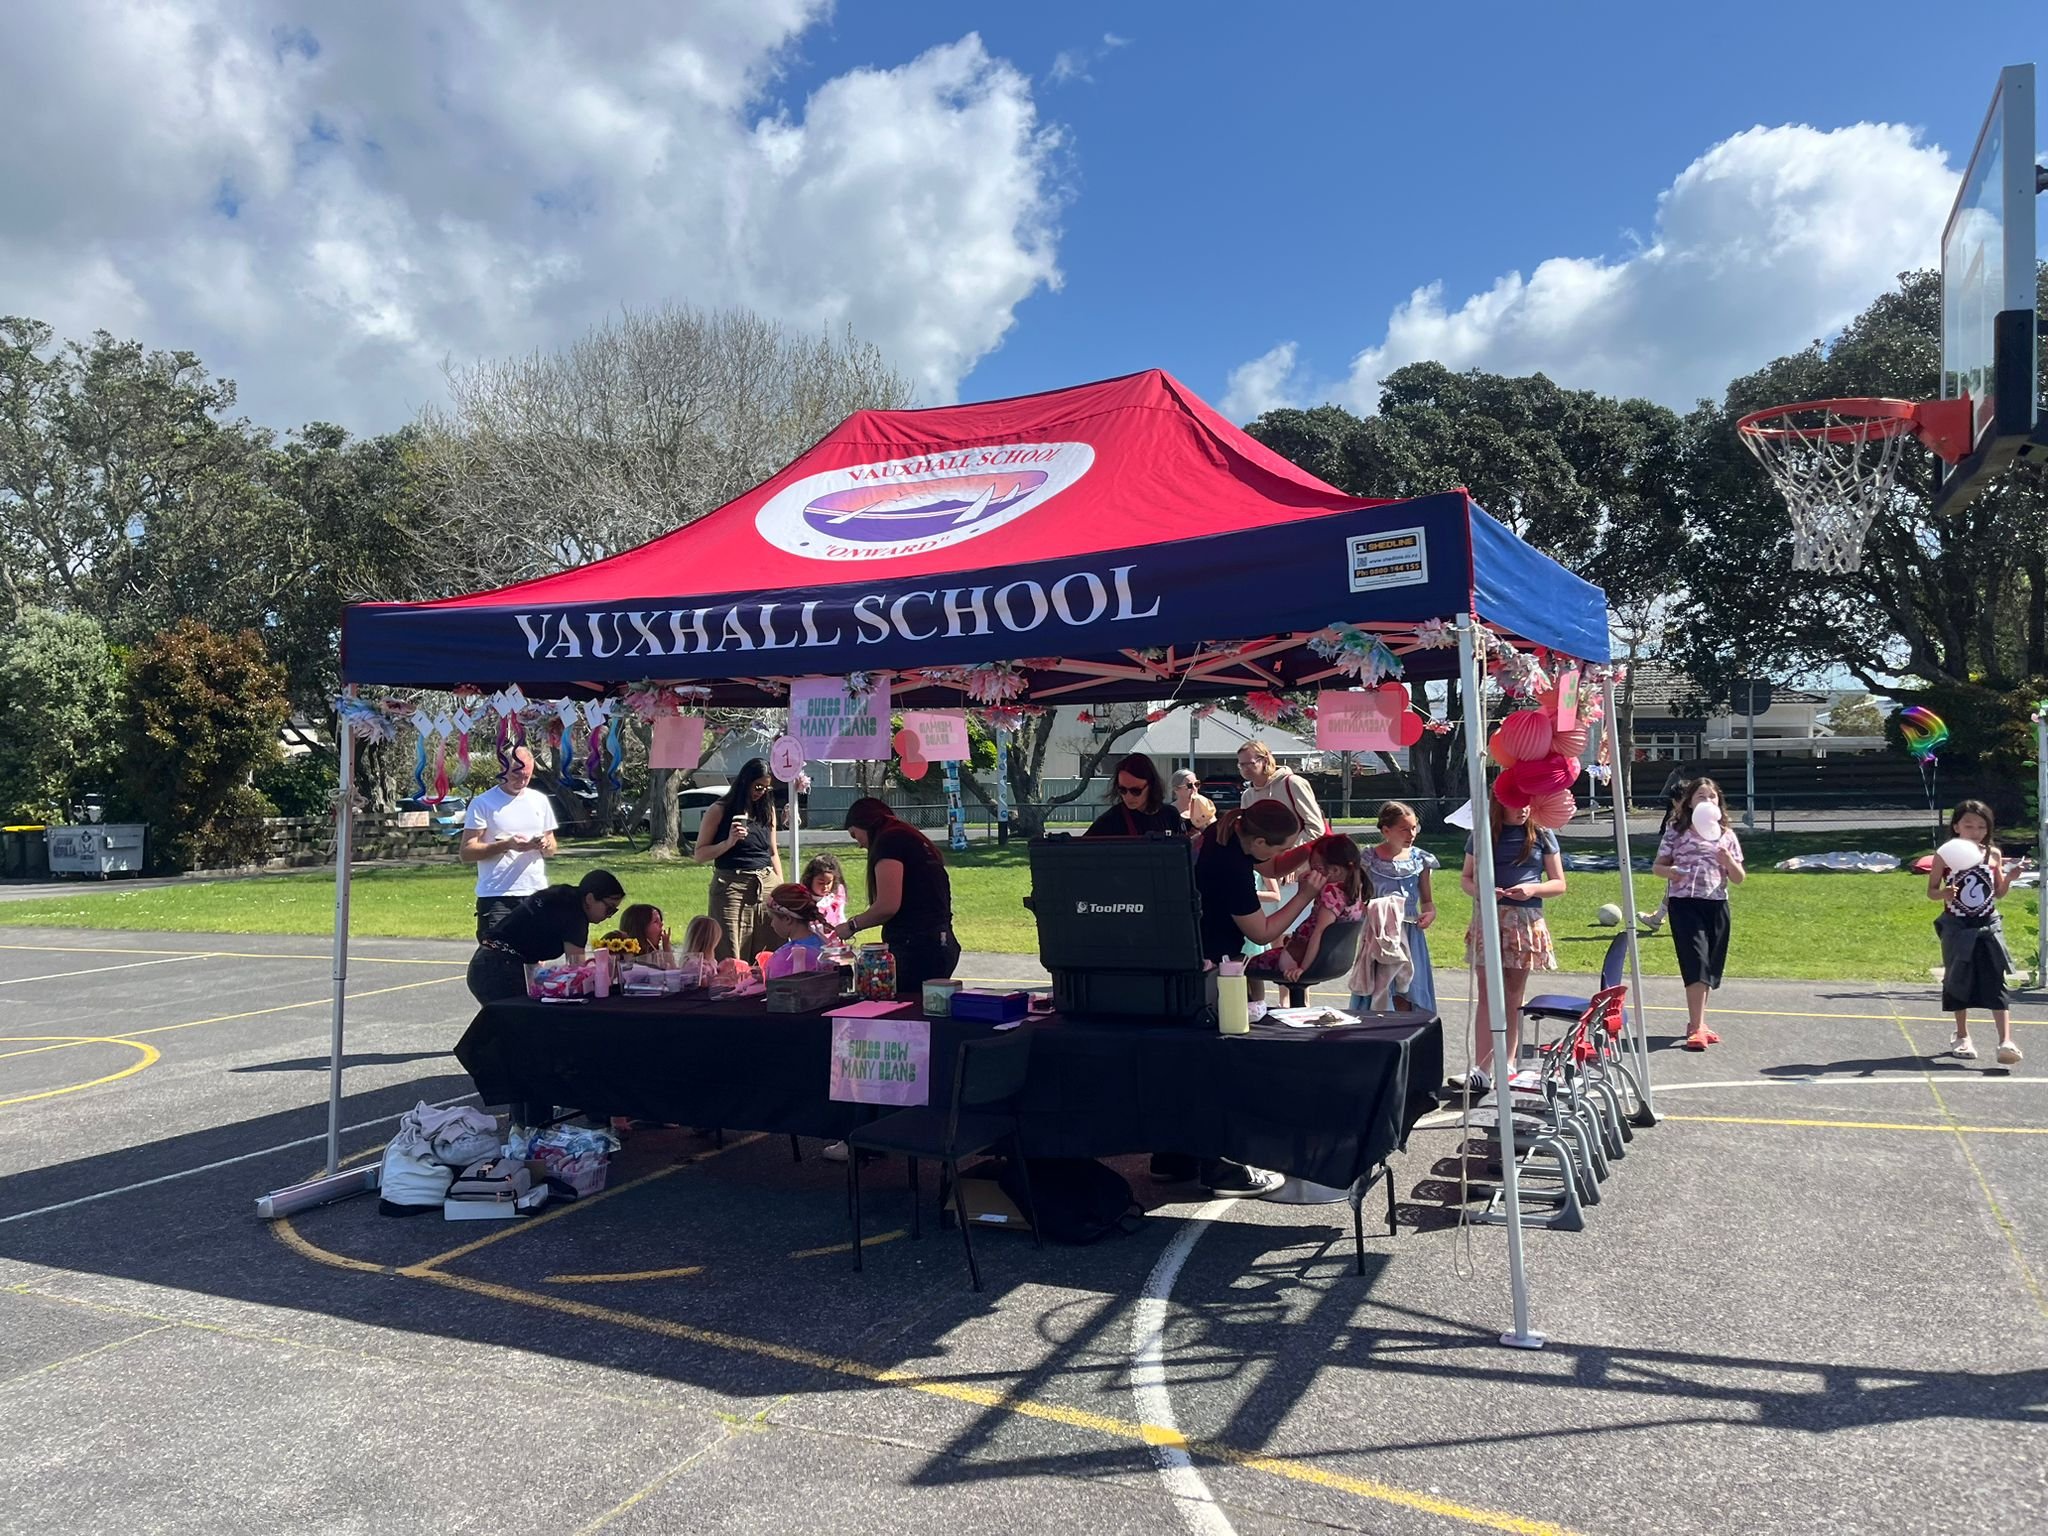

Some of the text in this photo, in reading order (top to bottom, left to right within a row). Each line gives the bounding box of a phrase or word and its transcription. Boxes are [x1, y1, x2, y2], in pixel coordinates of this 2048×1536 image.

[848, 454, 971, 481] VAUXHALL
[1368, 537, 1414, 550] SHEDLINE
[514, 564, 1160, 660] VAUXHALL SCHOOL
[807, 697, 840, 717] GUESS
[800, 717, 835, 737] MANY
[1089, 903, 1144, 913] ToolPRO
[884, 1041, 909, 1061] HOW
[841, 1059, 917, 1082] MANY BEANS
